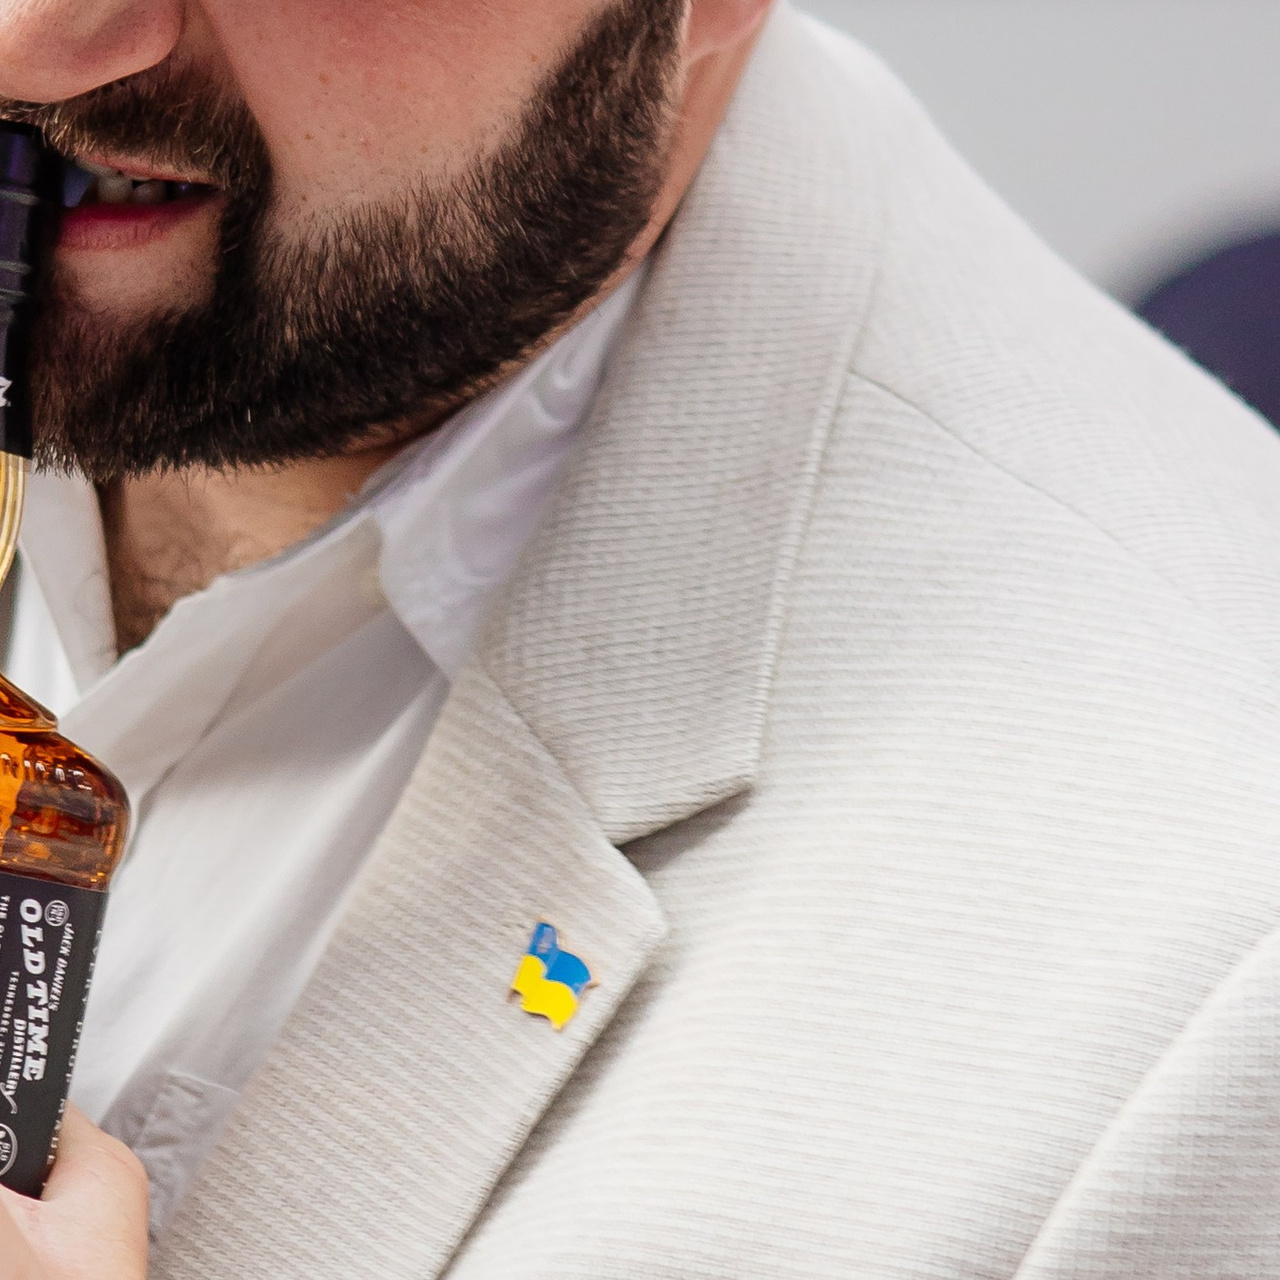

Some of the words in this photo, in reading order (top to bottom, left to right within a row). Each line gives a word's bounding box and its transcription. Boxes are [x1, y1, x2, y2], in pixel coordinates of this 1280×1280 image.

[20, 900, 44, 975] OLD
[60, 923, 74, 956] JACK
[48, 958, 67, 1011] DANIEL'S
[0, 1019, 26, 1114] DISTILLERY
[23, 981, 48, 1081] TIME
